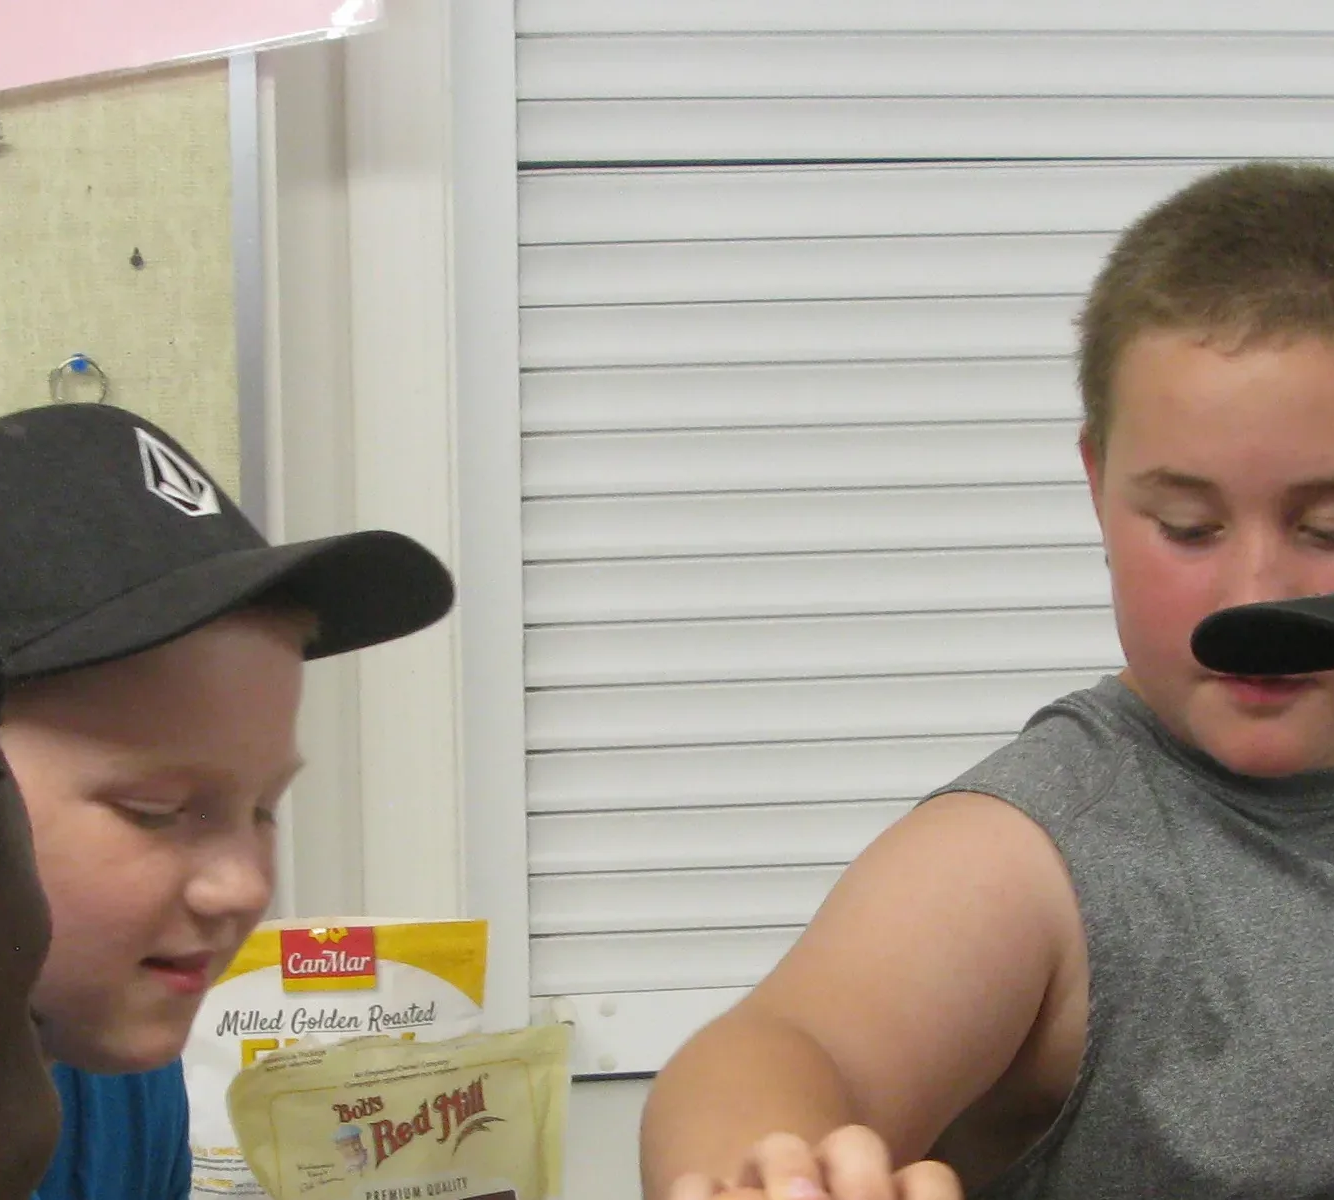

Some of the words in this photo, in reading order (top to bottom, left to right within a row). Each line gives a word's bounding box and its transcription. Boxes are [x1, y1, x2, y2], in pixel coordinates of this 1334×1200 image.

[286, 948, 372, 976] CanMar
[216, 1008, 283, 1037] Milled
[291, 1006, 361, 1035] Golden
[368, 1001, 436, 1028] Roasted
[332, 1096, 383, 1123] Bob's
[370, 1106, 432, 1168] Red
[433, 1075, 488, 1143] Mill
[426, 1178, 468, 1198] QUALITY
